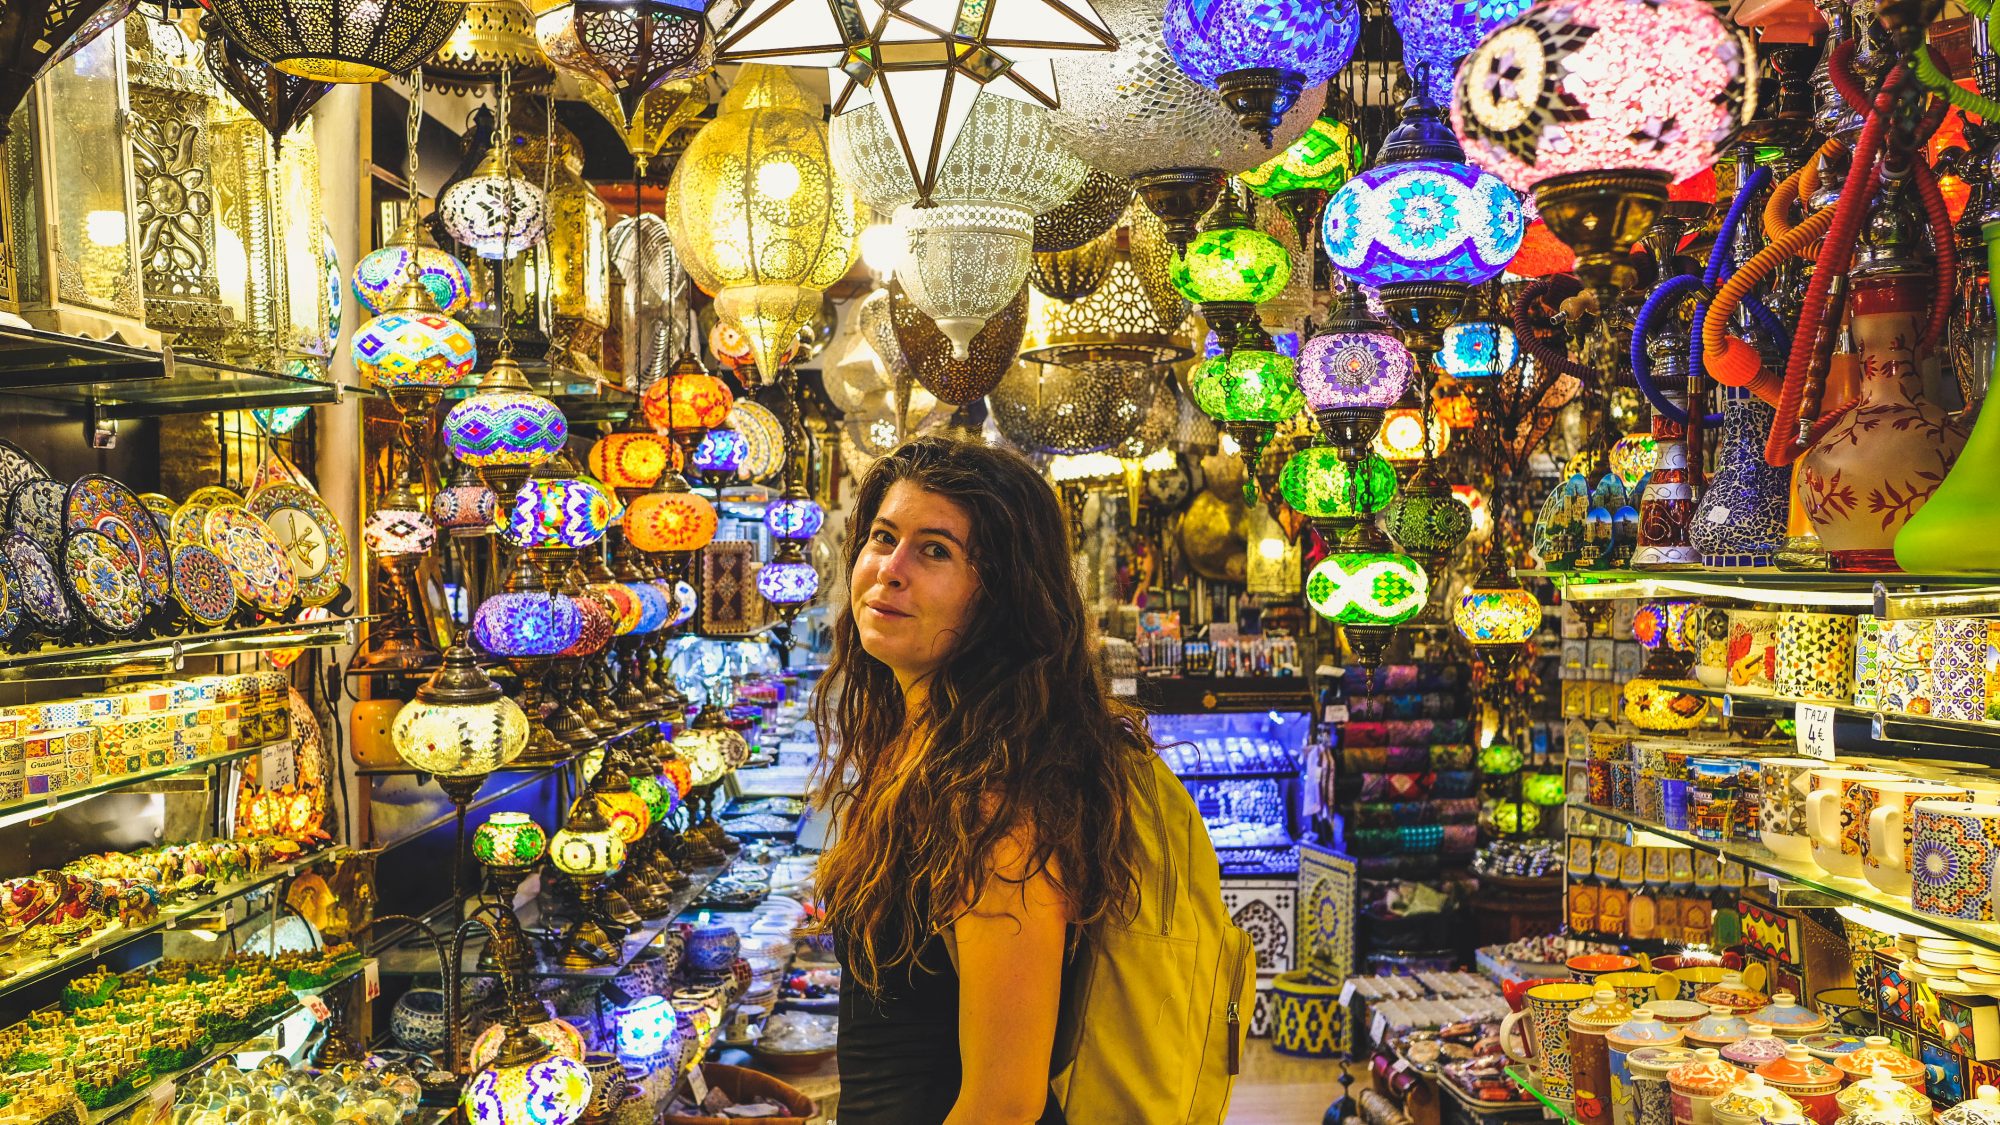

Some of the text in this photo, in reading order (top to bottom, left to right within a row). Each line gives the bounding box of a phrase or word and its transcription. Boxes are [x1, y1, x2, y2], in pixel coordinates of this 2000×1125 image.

[1804, 707, 1828, 723] TAZA
[1808, 724, 1825, 744] 4€
[30, 758, 62, 769] Granada
